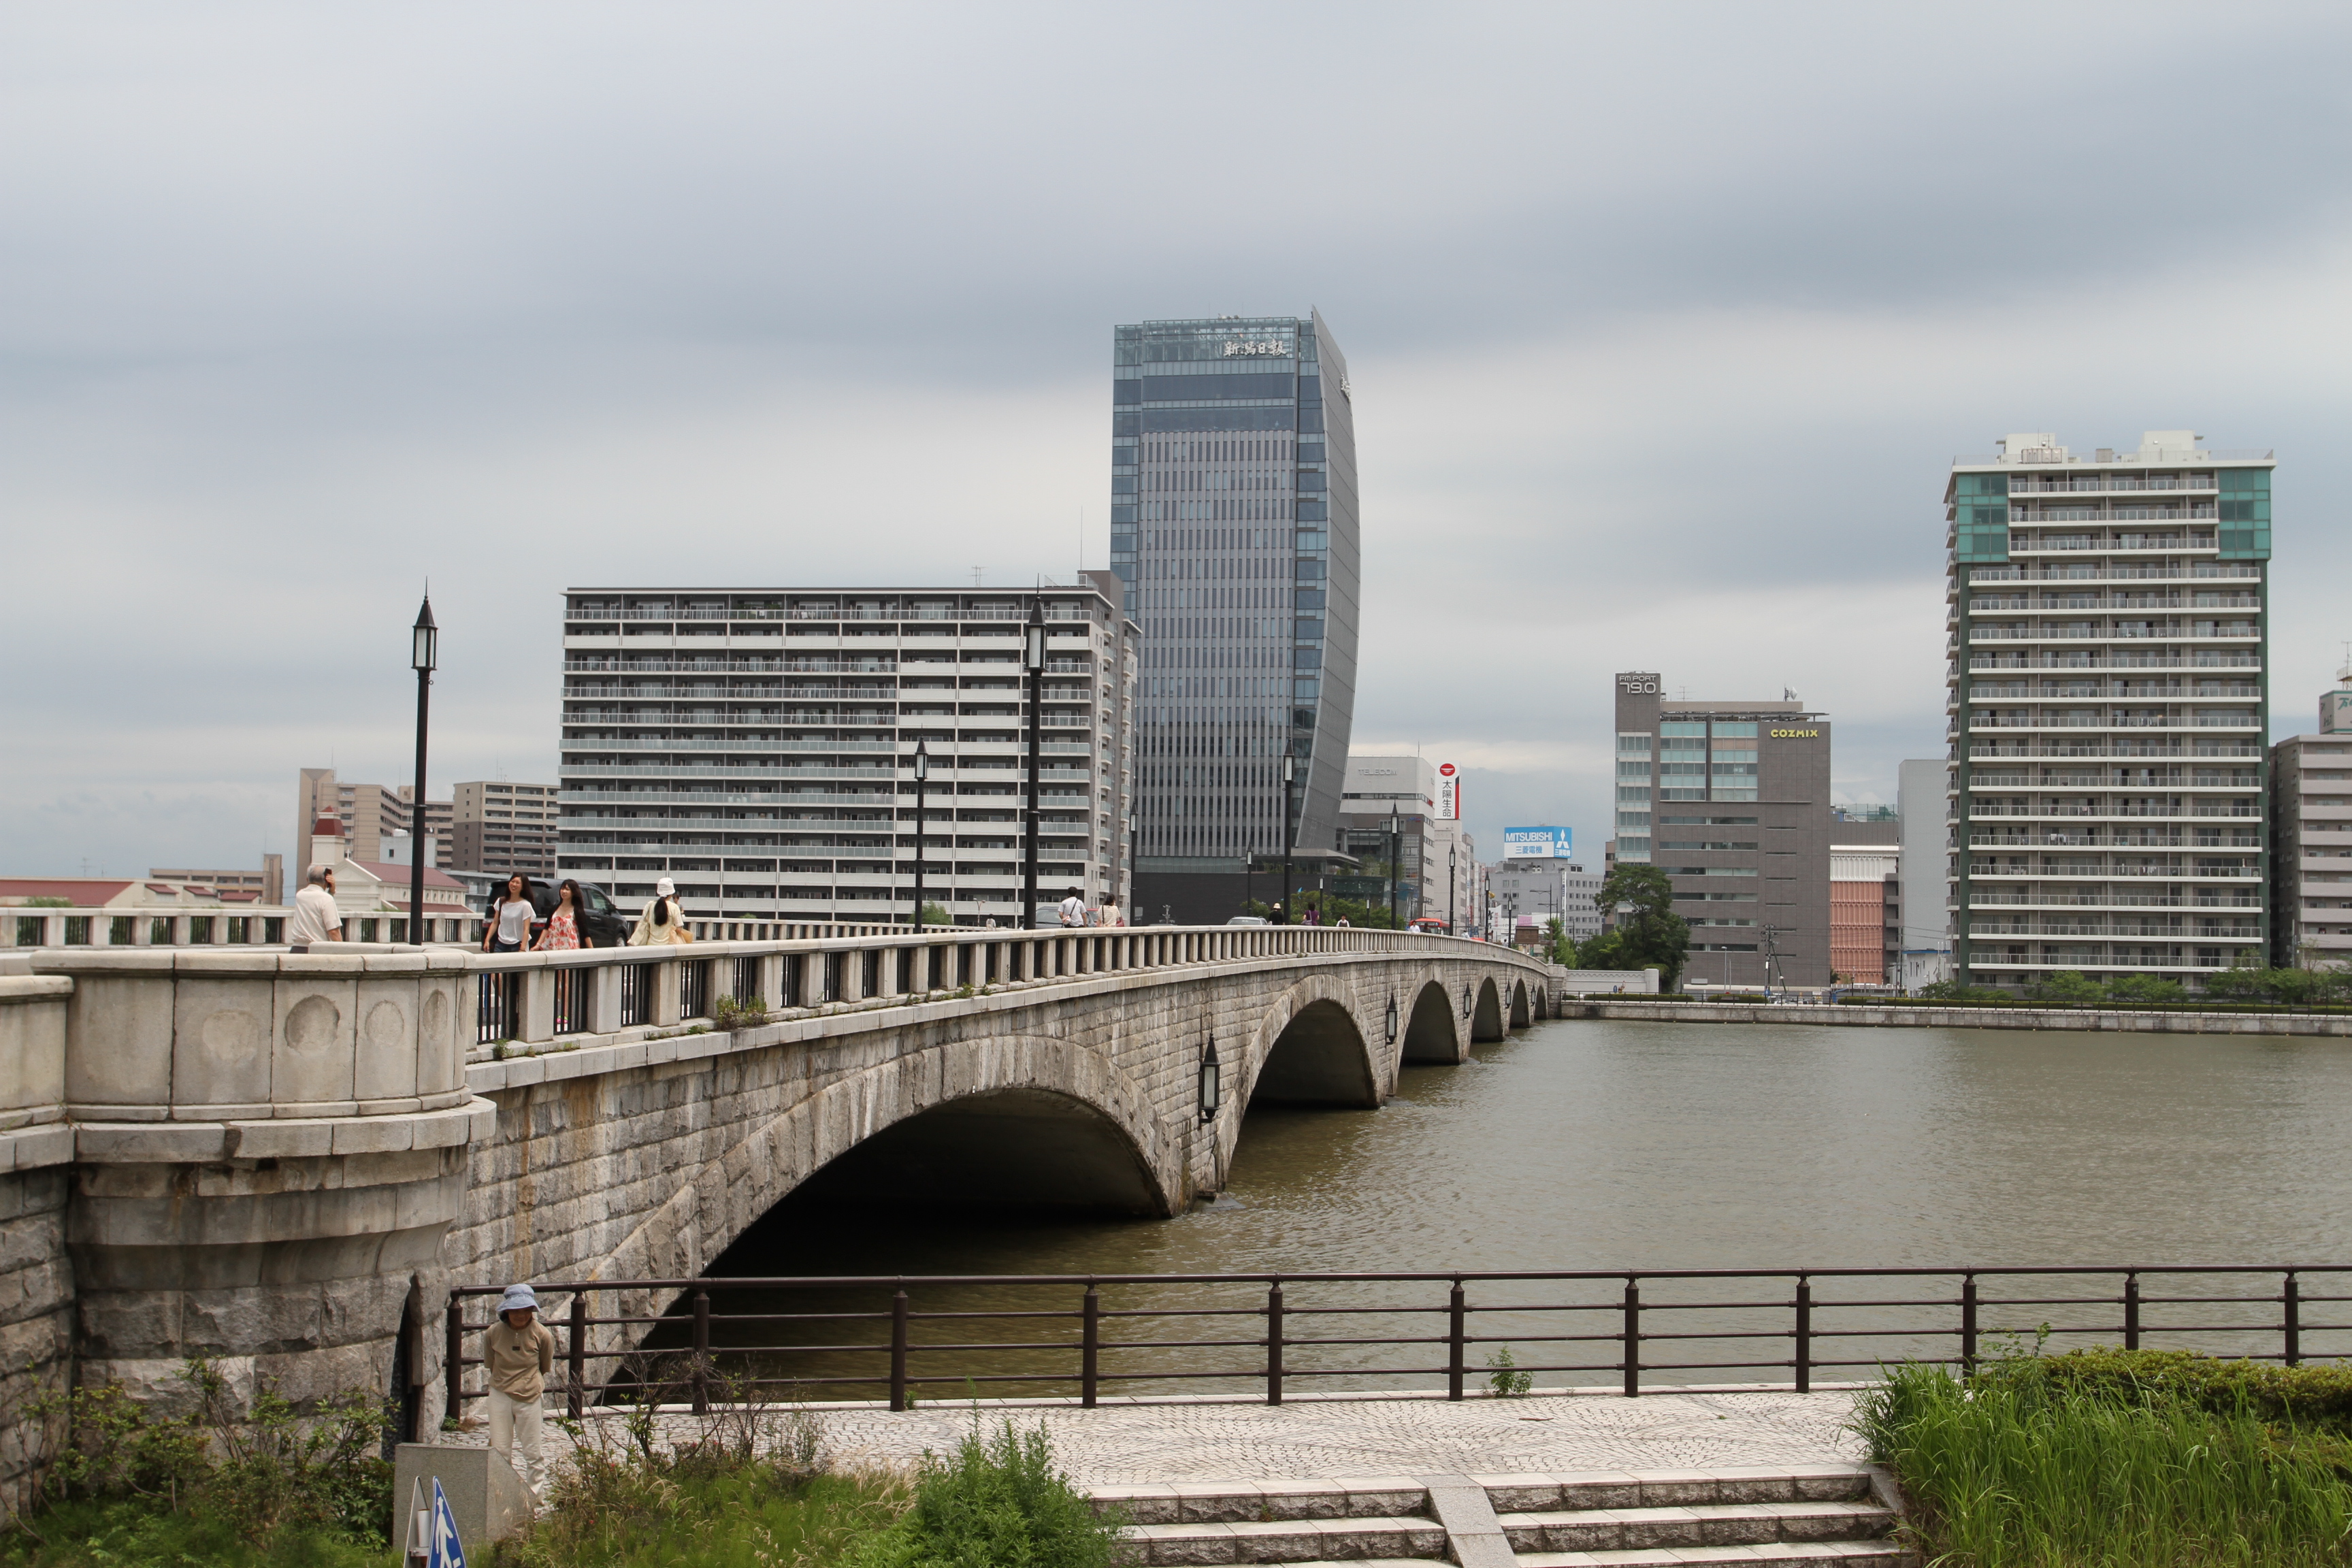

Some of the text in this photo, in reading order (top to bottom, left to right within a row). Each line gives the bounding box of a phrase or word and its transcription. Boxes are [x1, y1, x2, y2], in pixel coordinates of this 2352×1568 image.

[1224, 339, 1286, 357] 新潟日報
[1619, 682, 1656, 693] 79.0
[2338, 698, 2352, 710] 万
[1770, 729, 1818, 738] COZMIX
[1442, 780, 1452, 817] 太陽生命
[1505, 832, 1552, 842] MITSUBISHI
[1516, 845, 1542, 854] 三菱電機
[1554, 849, 1571, 857] 三菱電機
